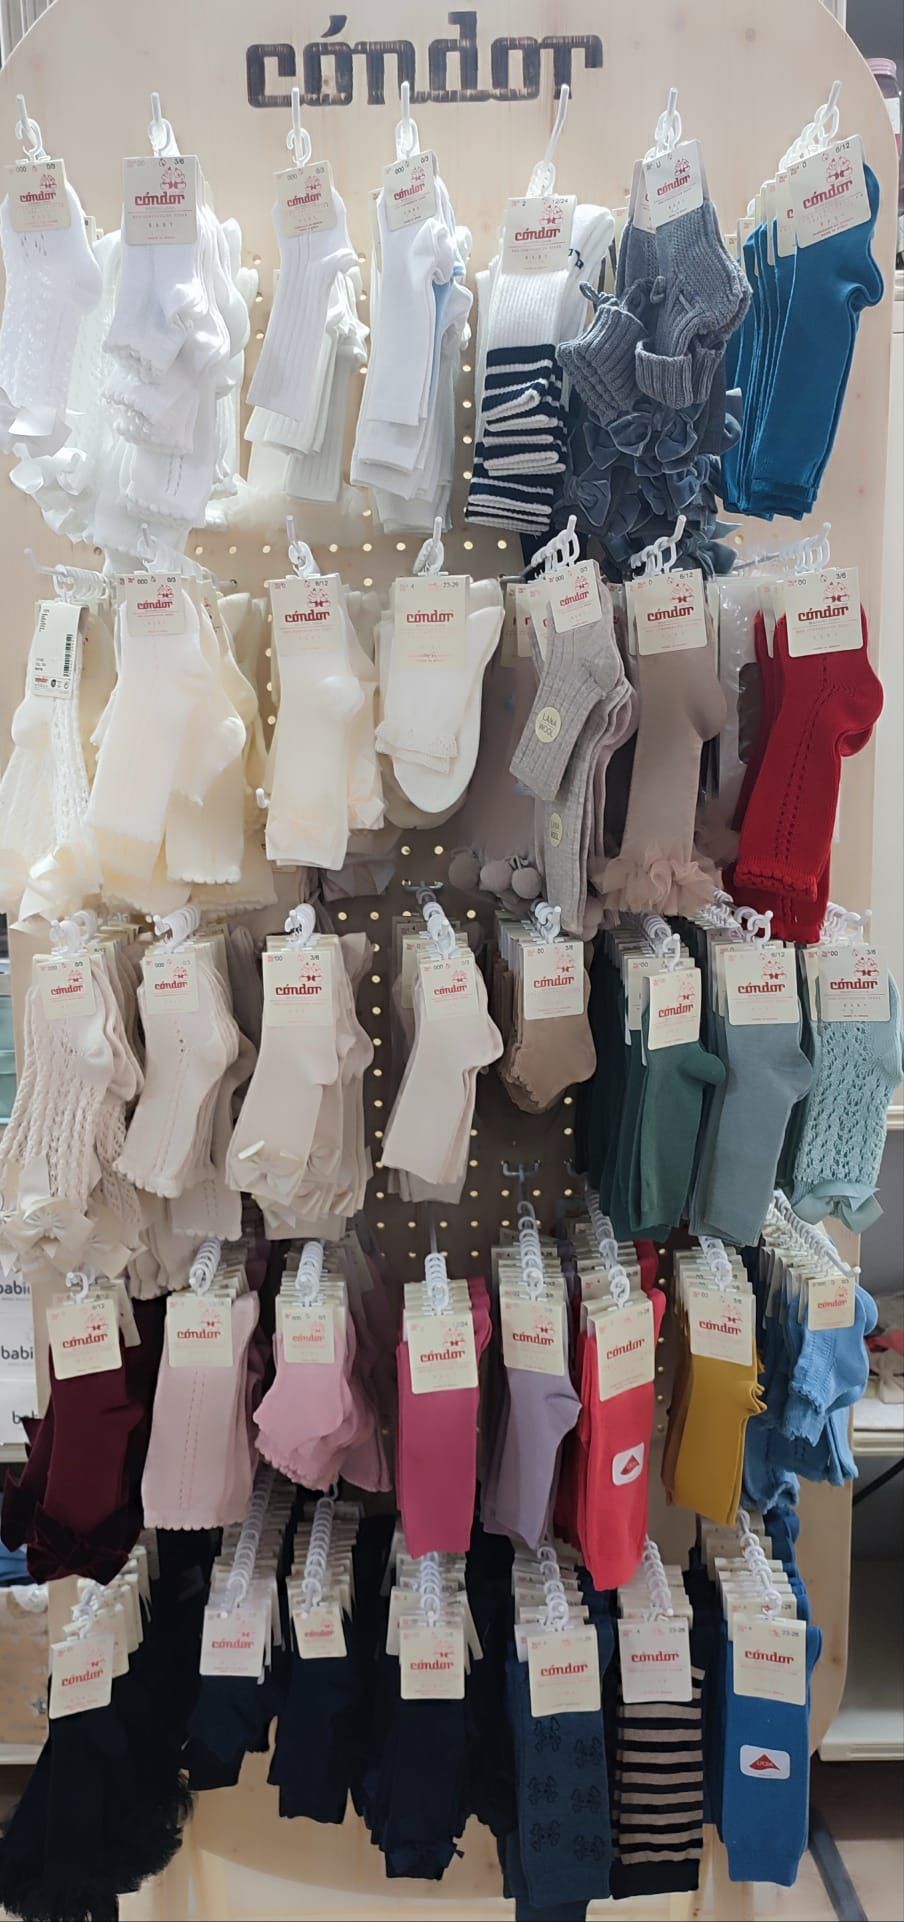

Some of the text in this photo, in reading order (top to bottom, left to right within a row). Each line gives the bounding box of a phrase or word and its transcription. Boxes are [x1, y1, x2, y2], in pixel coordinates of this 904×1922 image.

[246, 11, 603, 108] cóndor
[657, 174, 690, 196] cóndor
[20, 190, 57, 203] cóndor
[135, 191, 185, 206] cóndor
[287, 192, 322, 207] cóndor
[803, 180, 853, 209] cóndor
[515, 227, 560, 241] cóndor
[137, 599, 174, 610] cóndor
[560, 590, 590, 607] cóndor
[285, 609, 330, 623] cóndor
[406, 609, 454, 623] cóndor
[647, 605, 694, 622] cóndor
[798, 605, 849, 622] cóndor
[154, 980, 187, 990] cóndor
[533, 975, 575, 988] cóndor
[737, 982, 785, 994] cóndor
[830, 978, 878, 990] cóndor
[51, 984, 84, 995] cóndor
[275, 984, 322, 995] cóndor
[433, 983, 468, 996] cóndor
[658, 1003, 694, 1018] cóndor
[177, 1328, 221, 1339] cóndor
[699, 1319, 742, 1335] cóndor
[62, 1332, 108, 1348] cóndor
[512, 1331, 554, 1346] cóndor
[606, 1337, 645, 1360] cóndor
[420, 1350, 465, 1363] cóndor
[631, 1650, 679, 1663] cóndor
[745, 1649, 794, 1665] cóndor
[410, 1659, 454, 1671] cóndor
[540, 1662, 588, 1677] cóndor
